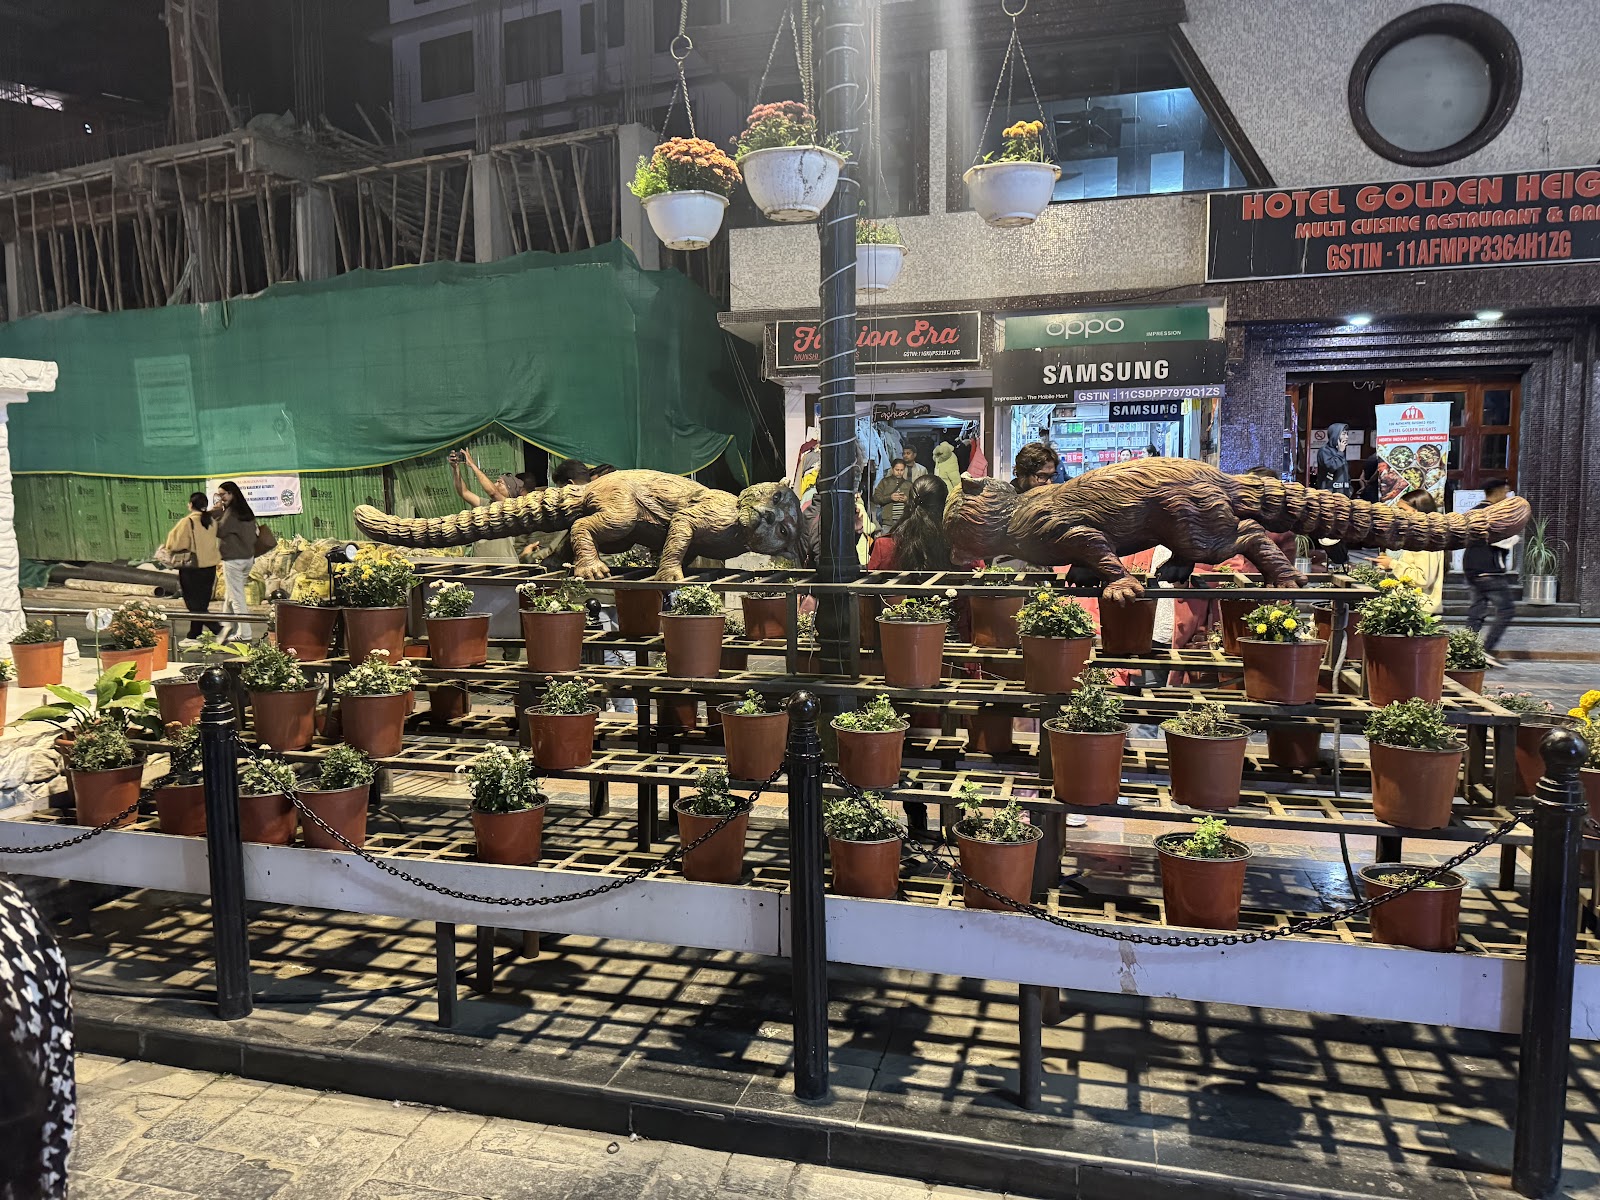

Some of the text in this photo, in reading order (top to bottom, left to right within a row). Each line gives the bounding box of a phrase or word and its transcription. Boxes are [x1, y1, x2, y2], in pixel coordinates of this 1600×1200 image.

[1242, 188, 1345, 220] HOTEL
[1356, 176, 1503, 212] GOLDEN
[1295, 220, 1346, 239] MULTI
[1351, 215, 1420, 234] CUISINE
[1426, 208, 1542, 230] RESTAURANT
[1546, 206, 1564, 223] &
[1326, 242, 1382, 271] GSTIN
[1396, 230, 1572, 266] 11AFMPP3364H1ZG
[906, 320, 960, 348] Era
[1046, 317, 1125, 340] oppo
[1043, 360, 1169, 384] SAMSUNG
[1078, 392, 1110, 401] GSTIN
[1120, 387, 1220, 400] 11CSDPP7979Q1ZS
[874, 404, 929, 422] Fashion era
[1112, 403, 1178, 416] SAMSUNG
